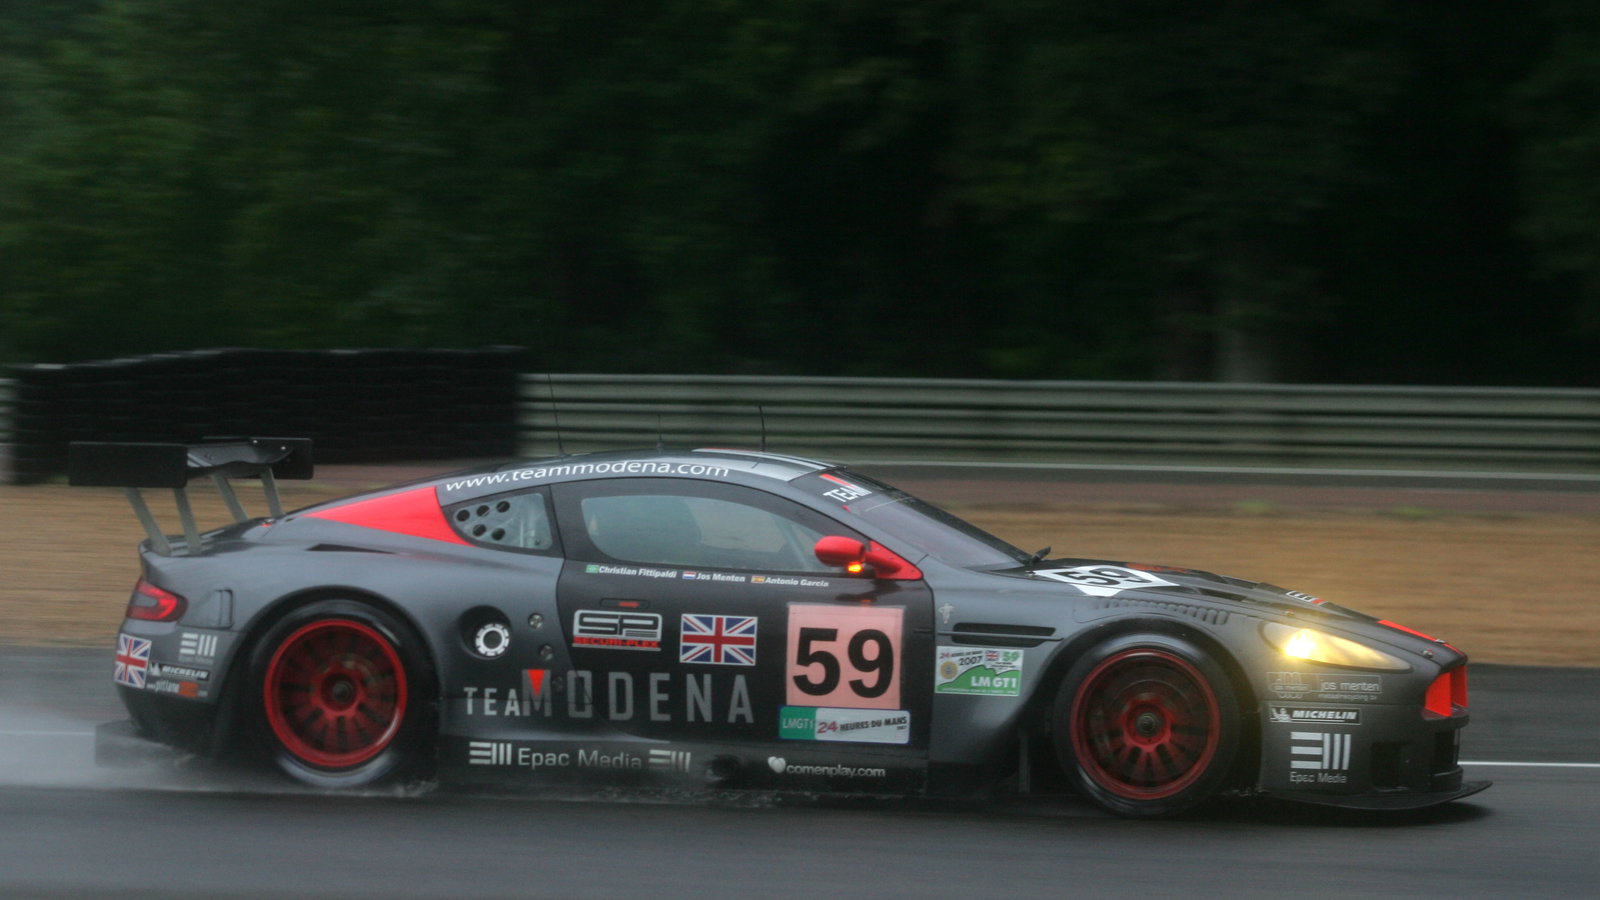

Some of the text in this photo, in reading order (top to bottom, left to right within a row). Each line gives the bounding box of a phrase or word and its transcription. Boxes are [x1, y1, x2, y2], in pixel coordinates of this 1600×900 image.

[446, 461, 729, 491] www.teammodena.com
[599, 565, 677, 578] Christian Fittipaldi
[696, 572, 745, 582] Jos Menten
[1054, 567, 1153, 586] 59
[765, 576, 799, 586] Antonio
[793, 627, 893, 698] 59
[959, 655, 983, 666] 2007
[1003, 652, 1020, 662] 59
[162, 665, 208, 678] MICHELIN
[1340, 681, 1380, 692] menten
[1292, 710, 1357, 719] MICHELIN
[783, 718, 814, 729] LMGT1
[817, 722, 838, 734] 24
[840, 720, 869, 732] HEURES
[870, 719, 882, 728] DU
[884, 715, 907, 727] MANS
[518, 748, 642, 769] Epac Media
[786, 763, 886, 778] comenplay.com
[1290, 772, 1347, 784] Epac Media
